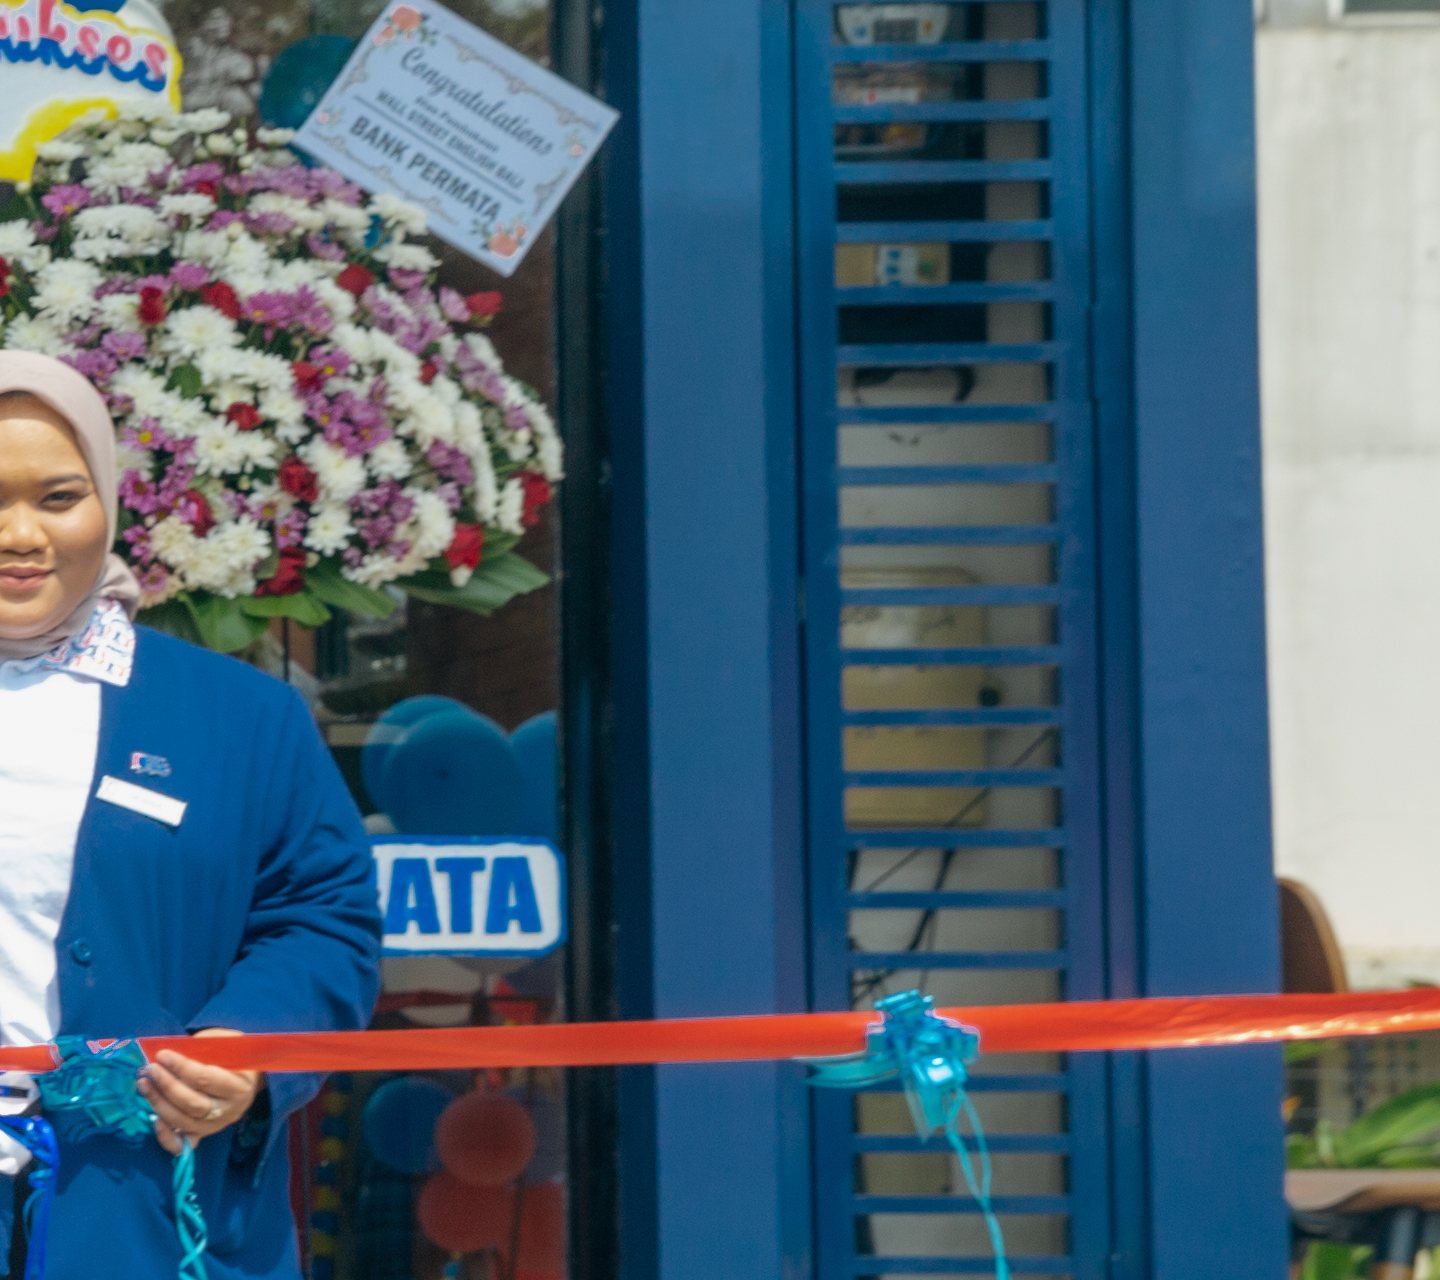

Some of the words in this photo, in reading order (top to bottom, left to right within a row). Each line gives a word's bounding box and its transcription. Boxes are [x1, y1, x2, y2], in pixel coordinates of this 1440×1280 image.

[400, 46, 554, 156] Congratulations
[349, 116, 410, 163] BANK
[407, 154, 502, 221] PERMATA
[373, 856, 542, 934] ATA
